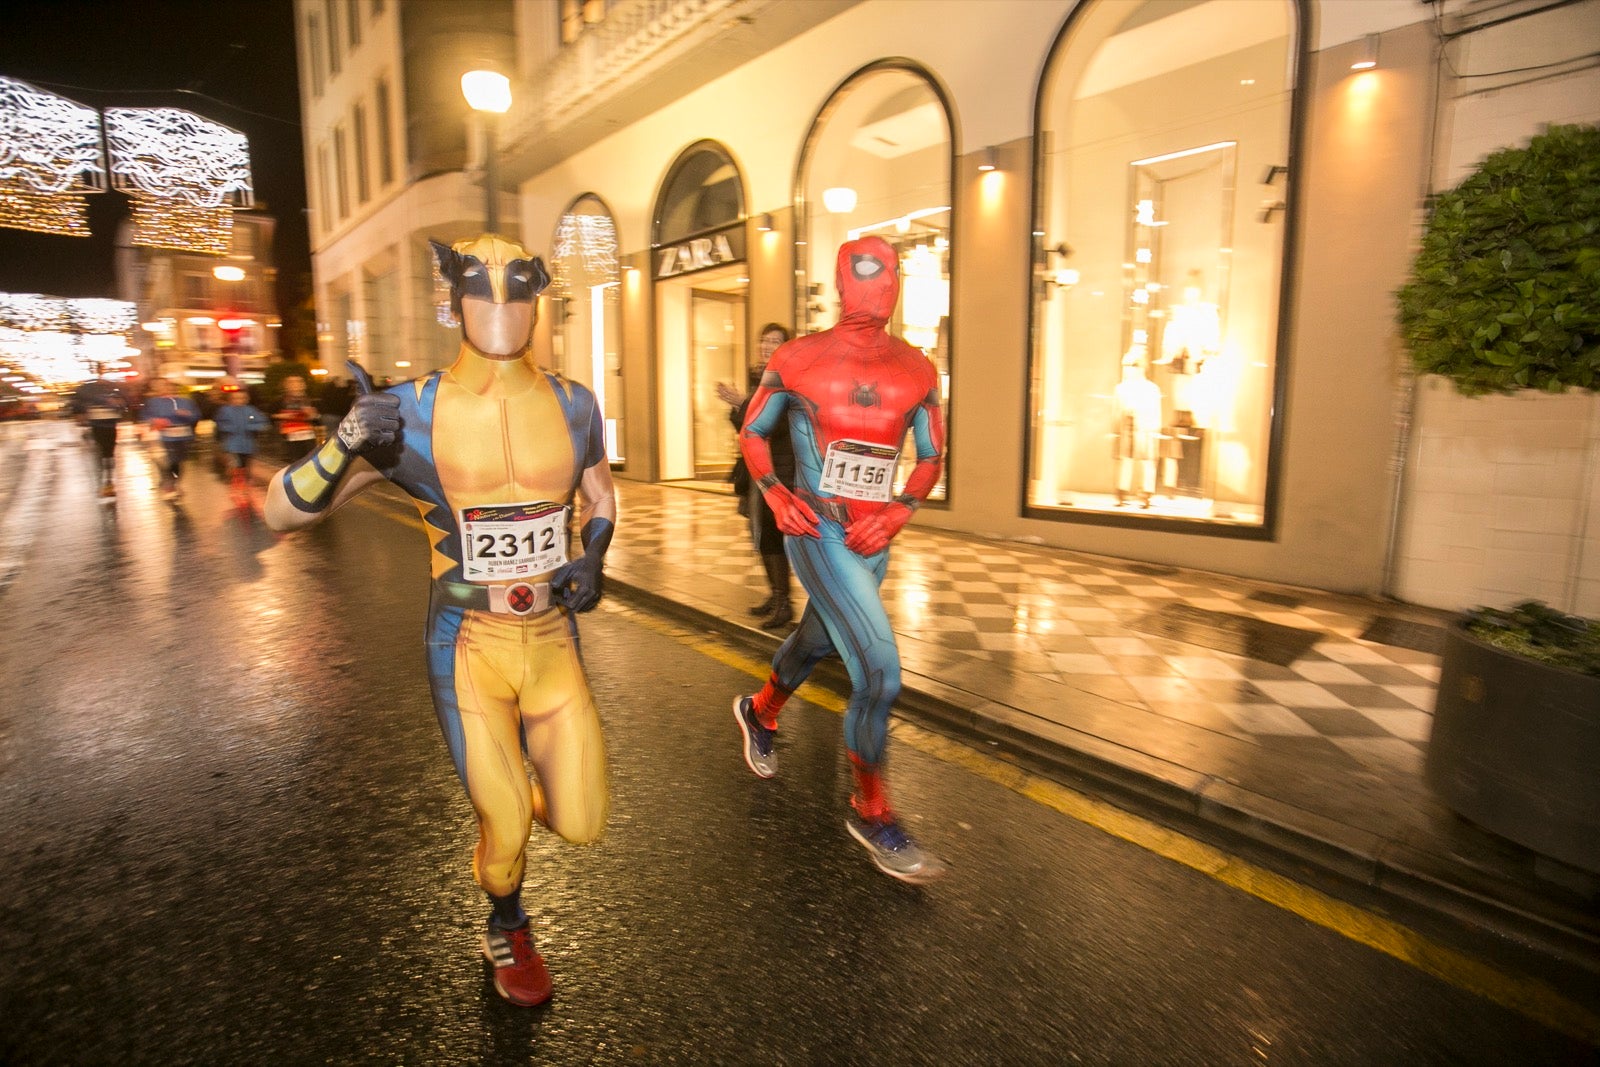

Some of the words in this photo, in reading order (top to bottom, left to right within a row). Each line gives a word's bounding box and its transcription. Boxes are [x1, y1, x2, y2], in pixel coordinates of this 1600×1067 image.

[658, 234, 735, 277] ZARA
[835, 461, 886, 485] 1156
[476, 526, 555, 558] 2312
